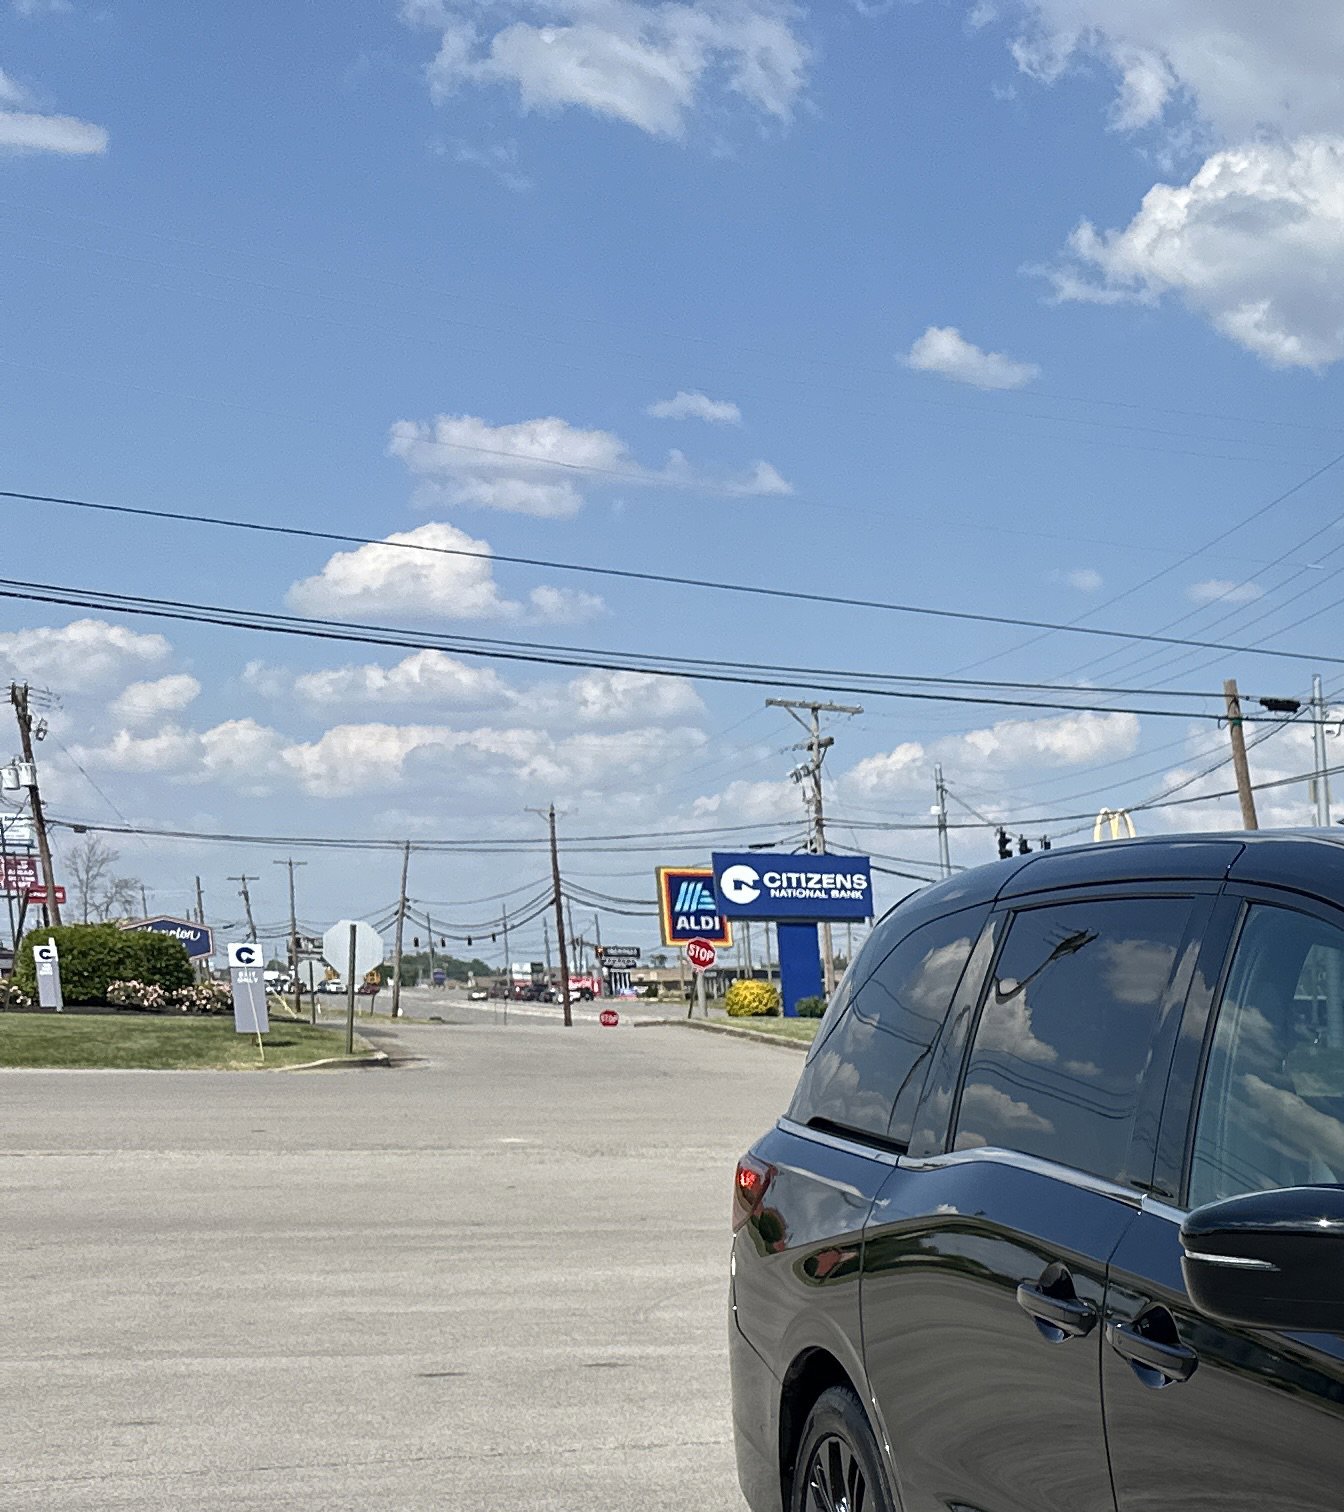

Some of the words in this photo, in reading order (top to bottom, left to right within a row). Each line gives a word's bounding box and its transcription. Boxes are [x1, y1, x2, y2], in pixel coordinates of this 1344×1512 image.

[763, 871, 868, 890] CITIZENS
[770, 888, 828, 899] NATIONAL
[830, 889, 863, 900] BANK
[676, 915, 720, 931] ALDI
[688, 943, 714, 962] STOP
[601, 1013, 618, 1024] STOP
